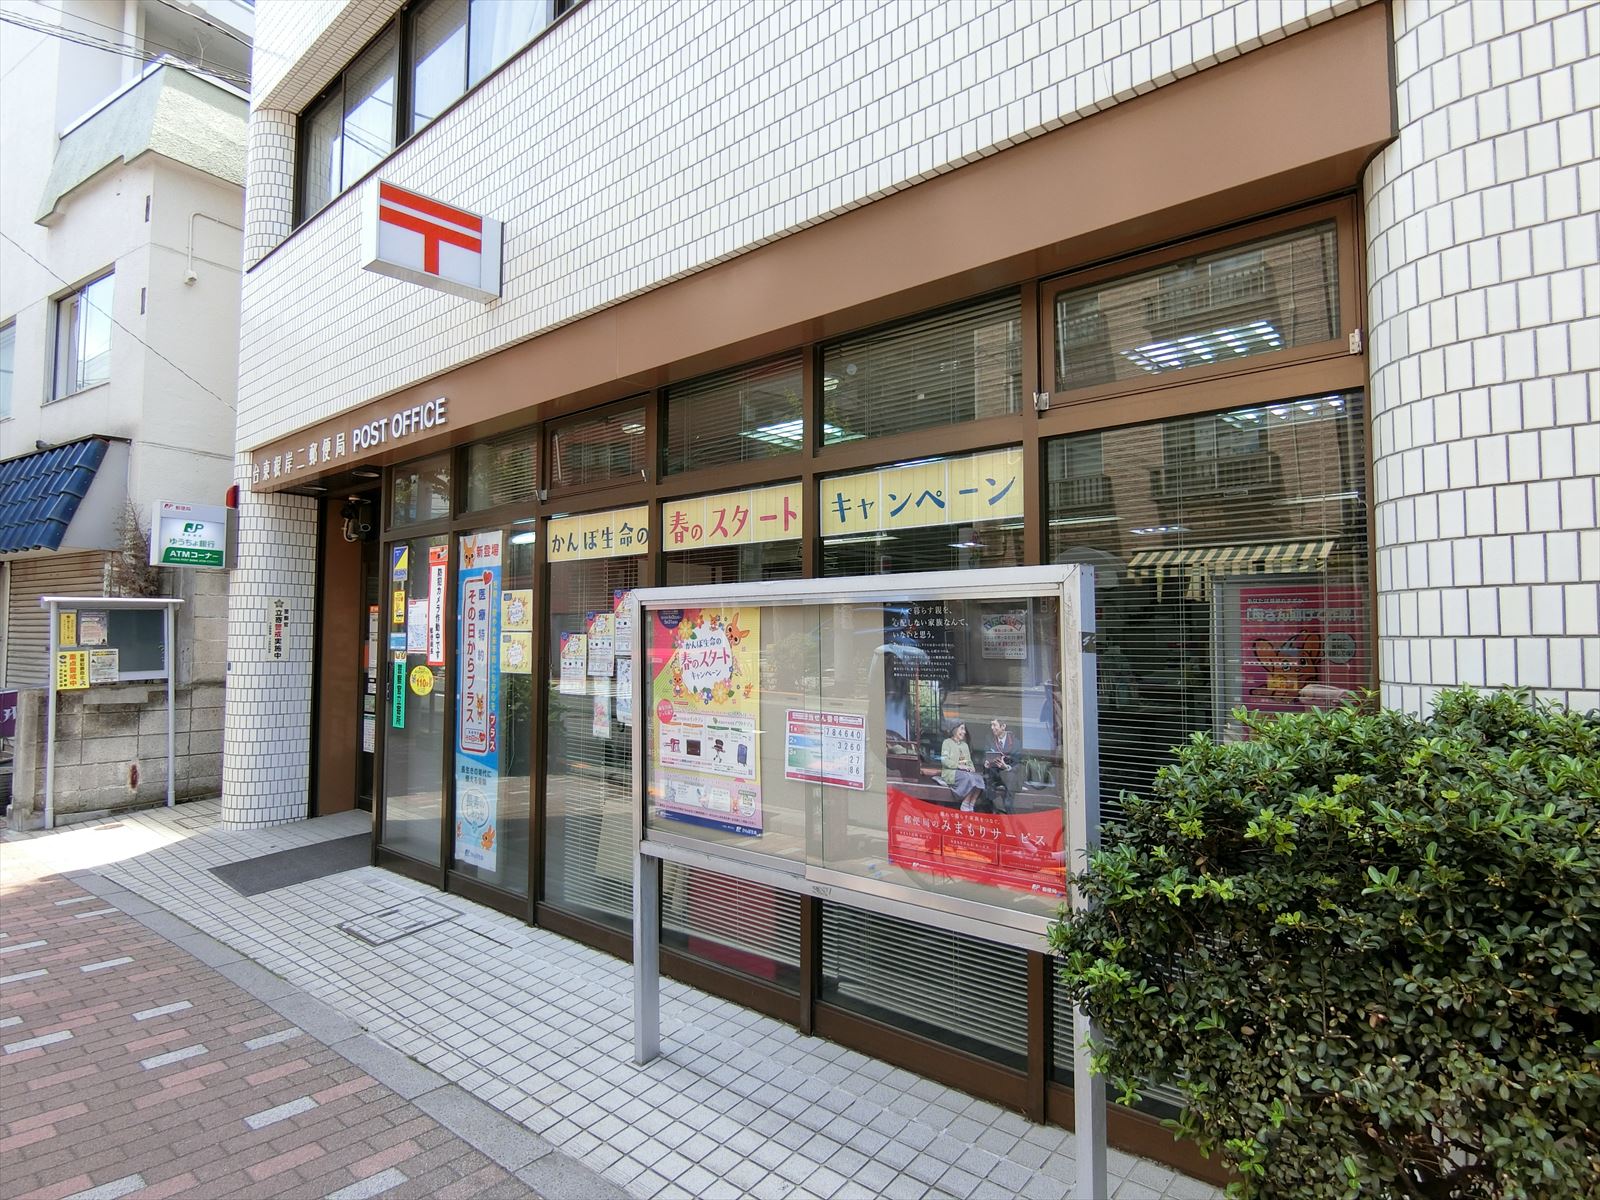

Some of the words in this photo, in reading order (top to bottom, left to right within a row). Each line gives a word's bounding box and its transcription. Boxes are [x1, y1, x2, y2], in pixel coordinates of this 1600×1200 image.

[253, 433, 345, 484] 台東根岸二郵便局
[353, 417, 389, 453] POST
[392, 397, 447, 439] OFFICE
[551, 521, 649, 553] かんぽ生命の
[669, 496, 798, 544] 春のスタート
[831, 476, 1016, 522] キャンペーン
[169, 537, 215, 548] ゆうちょ銀行
[169, 550, 219, 560] ATMコーナー
[476, 543, 499, 559] 新登場
[892, 616, 969, 627] 心配しない家族なんて、
[686, 636, 722, 650] かんぽ生命の
[466, 589, 477, 723] その日からプラス
[681, 647, 731, 671] 春のスタート
[849, 765, 860, 775] 86
[903, 814, 1046, 847] 郵便局のみまもりサービス
